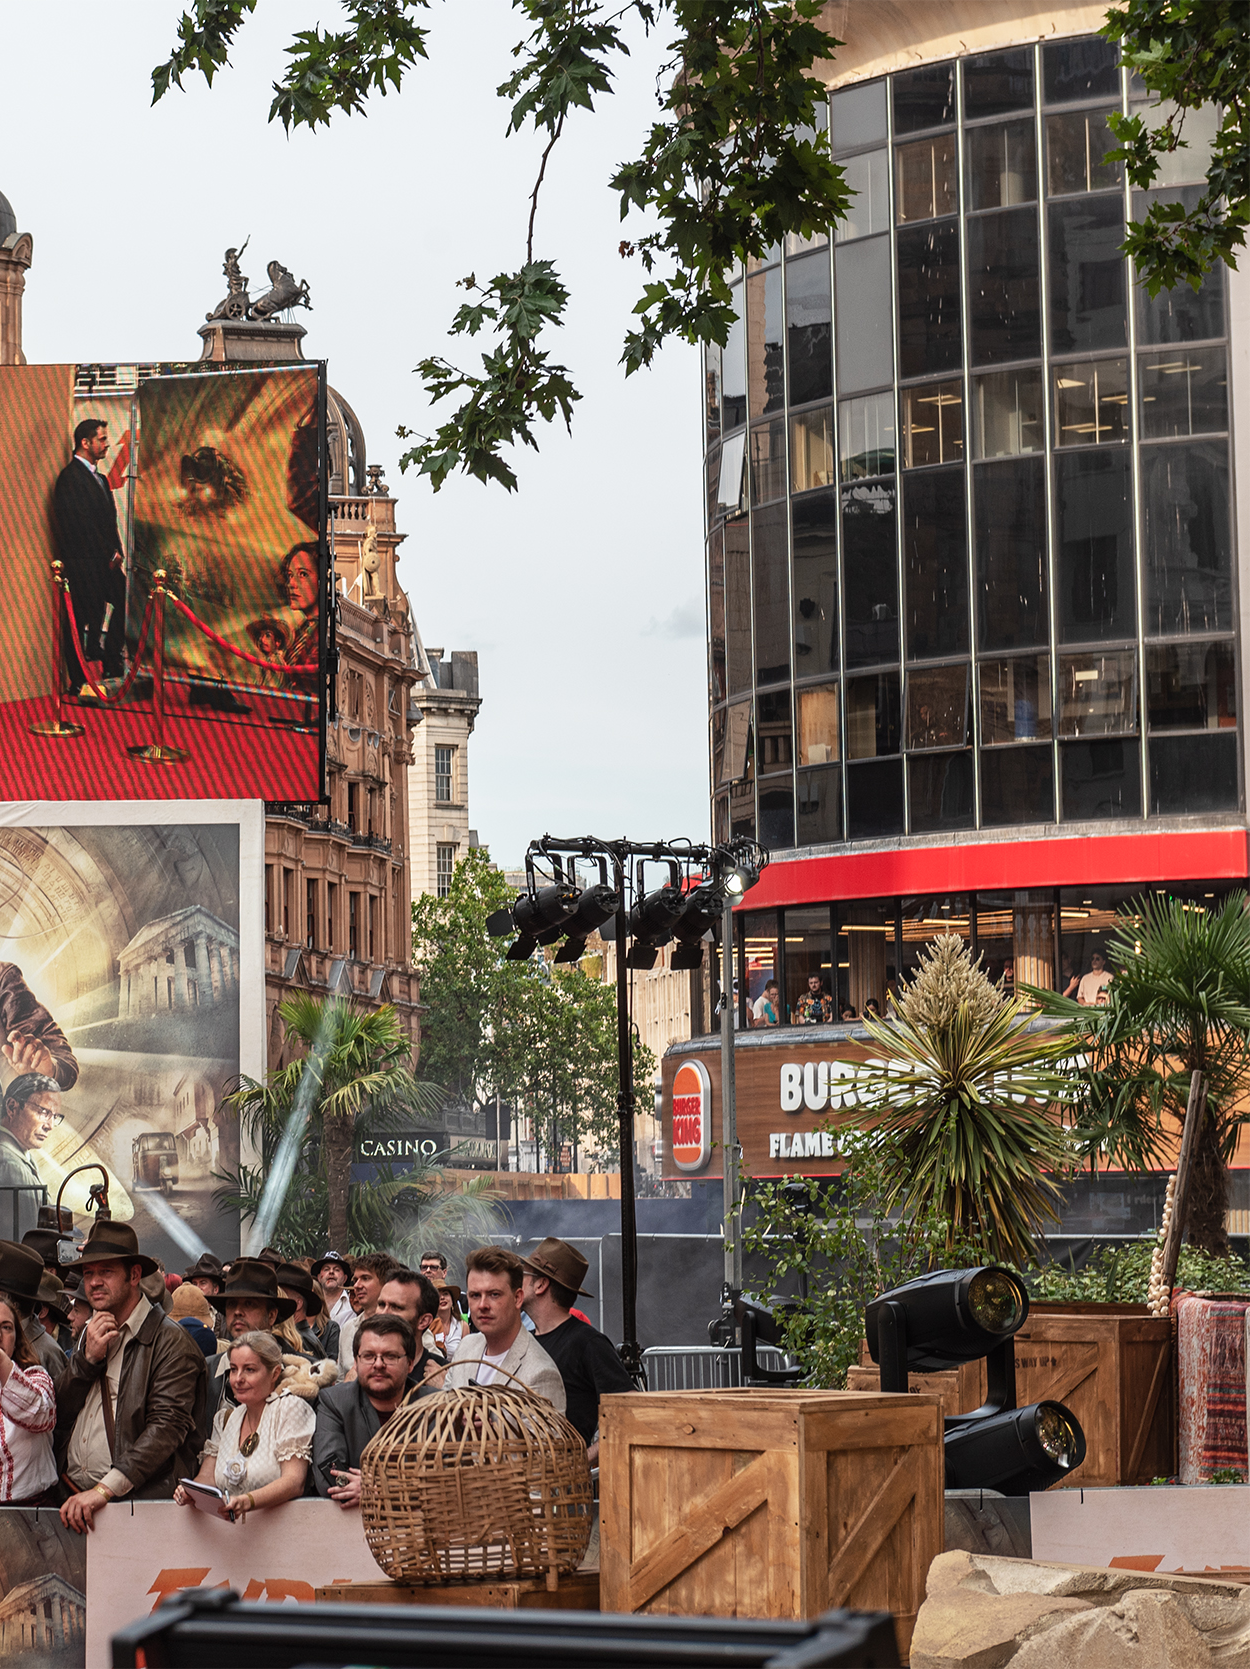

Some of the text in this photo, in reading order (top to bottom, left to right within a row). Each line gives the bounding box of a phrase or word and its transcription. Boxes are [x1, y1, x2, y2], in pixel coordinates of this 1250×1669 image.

[673, 1096, 701, 1116] BURGER
[673, 1116, 701, 1146] KING
[360, 1139, 437, 1156] CASINO
[769, 1132, 834, 1158] FLAME
